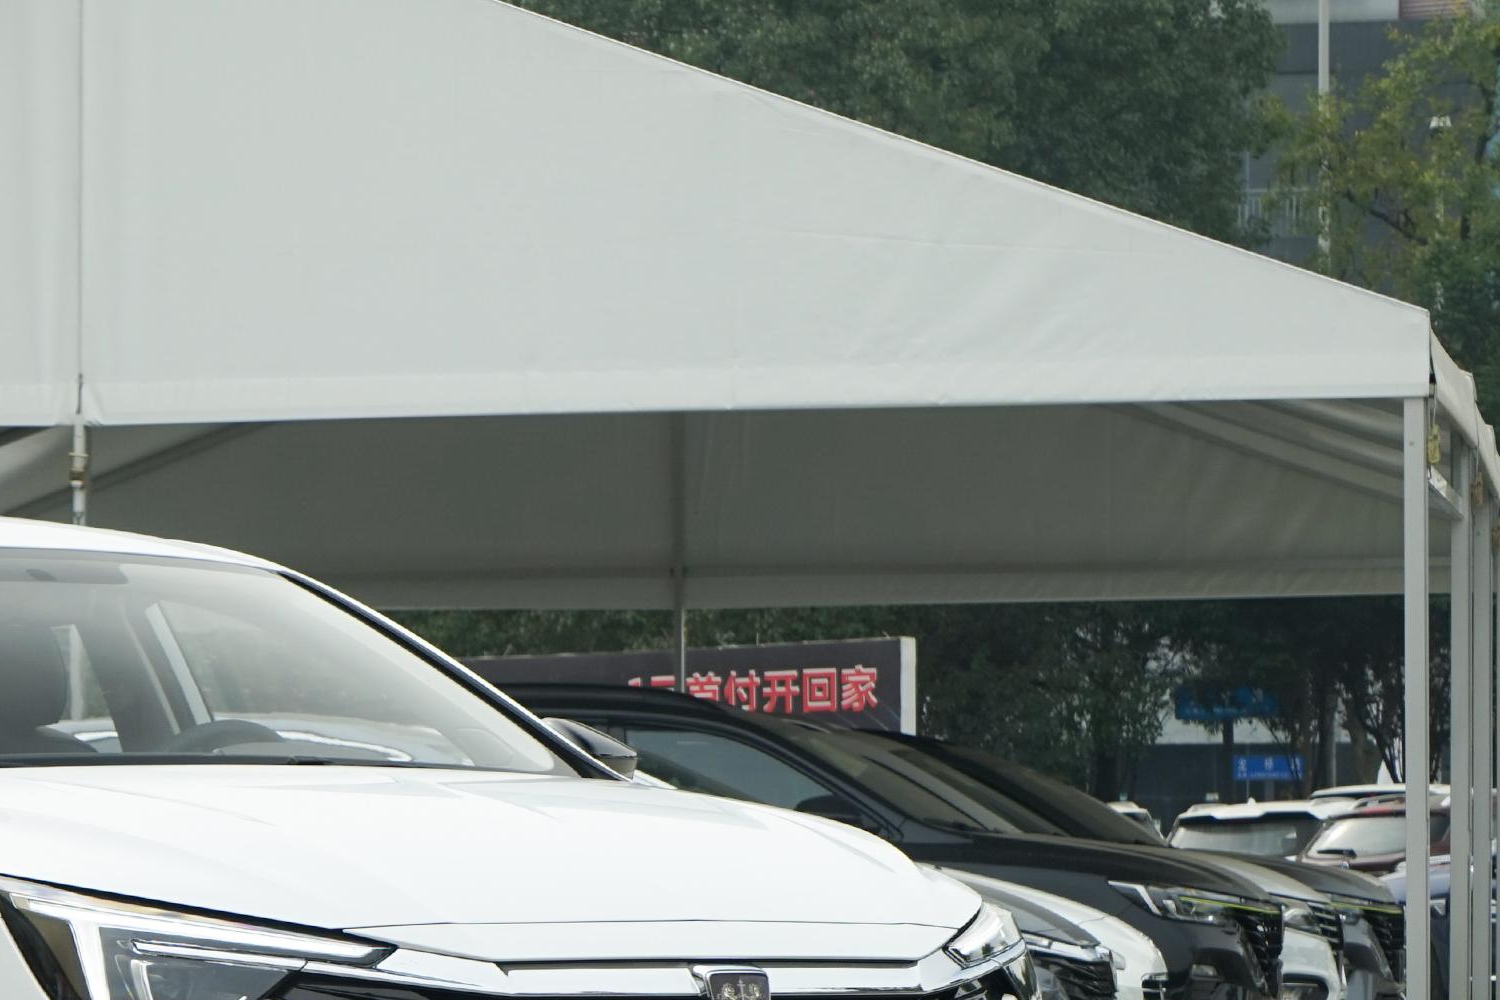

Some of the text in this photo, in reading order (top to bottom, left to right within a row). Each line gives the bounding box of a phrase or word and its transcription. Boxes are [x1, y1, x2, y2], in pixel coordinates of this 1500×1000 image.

[627, 664, 879, 714] 首付开回家
